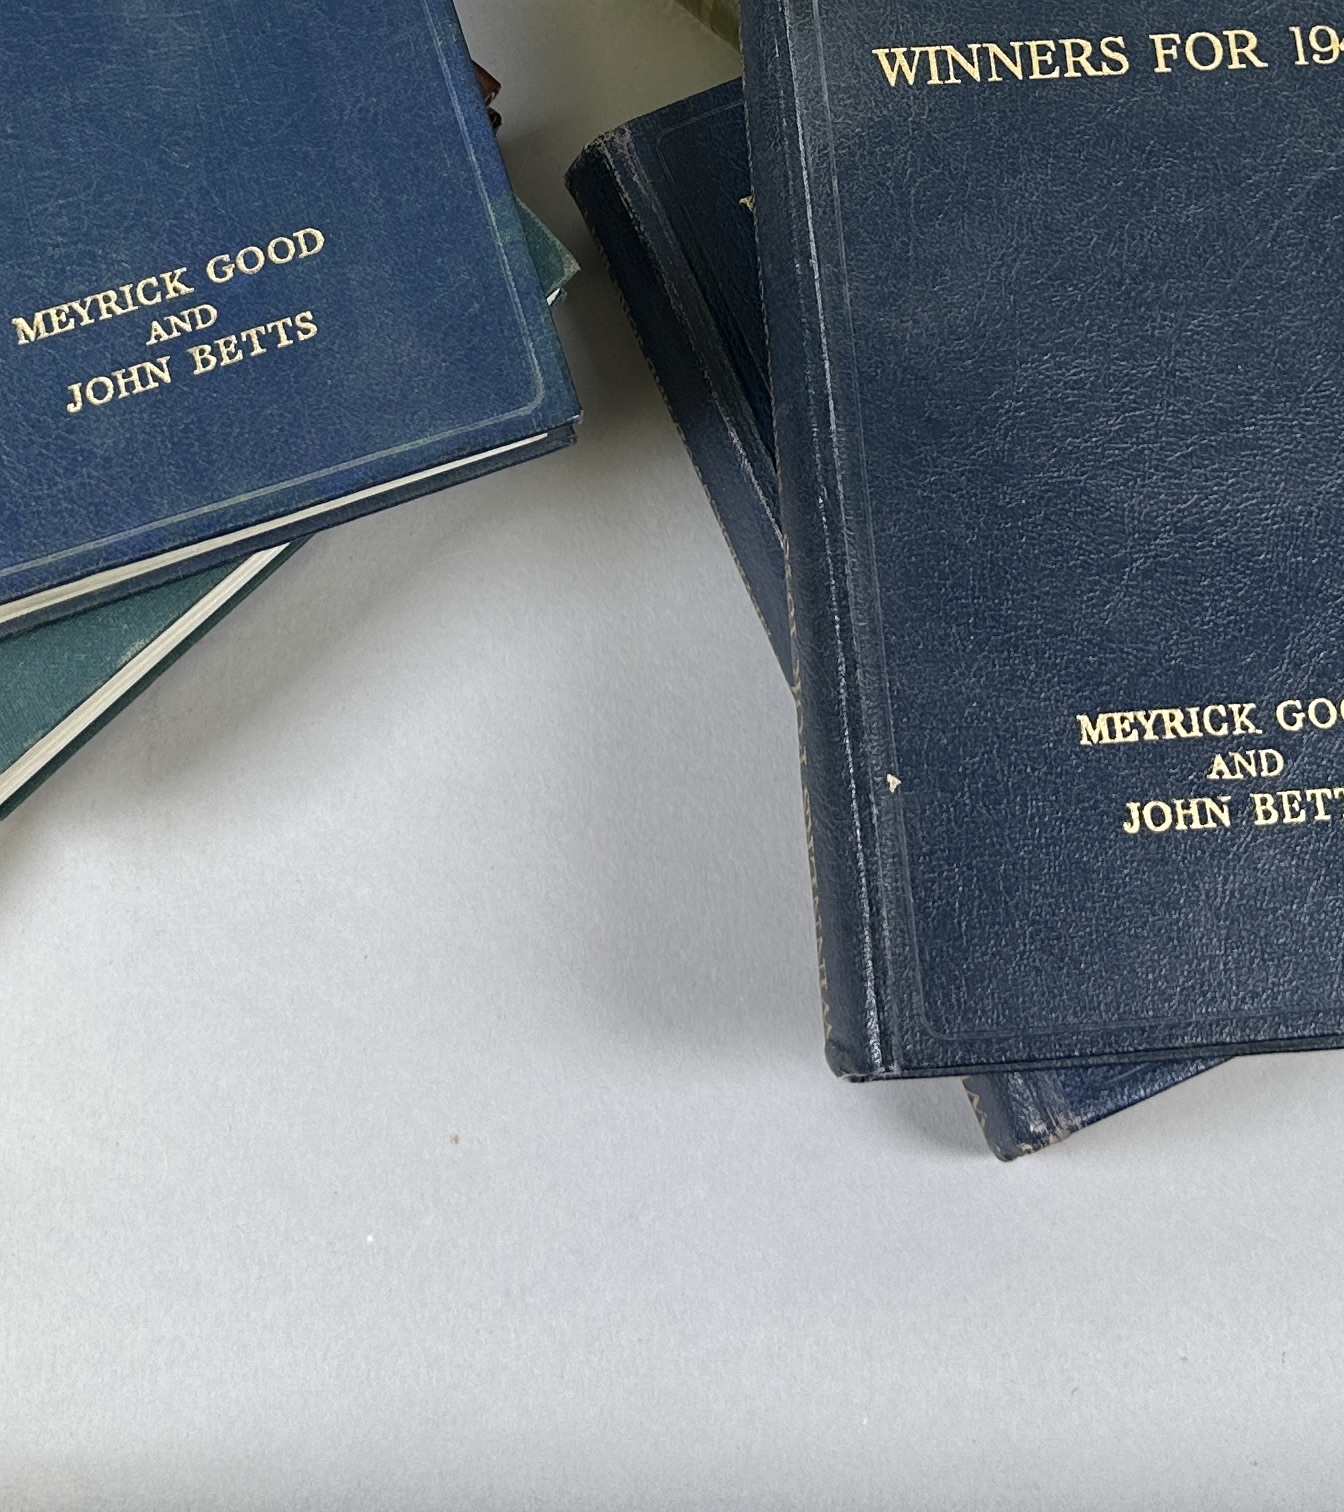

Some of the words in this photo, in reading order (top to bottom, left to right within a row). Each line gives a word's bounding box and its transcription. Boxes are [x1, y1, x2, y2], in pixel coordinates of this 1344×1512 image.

[871, 34, 1131, 88] WINNERS
[1148, 27, 1269, 75] FOR
[11, 266, 195, 346] MEYRICK
[206, 226, 326, 285] GOOD
[145, 302, 219, 346] AND
[65, 355, 173, 414] JOHN
[185, 310, 319, 376] BETTS
[1075, 702, 1263, 747] MEYRICK
[1206, 747, 1286, 781] AND
[1122, 794, 1233, 835] JOHN
